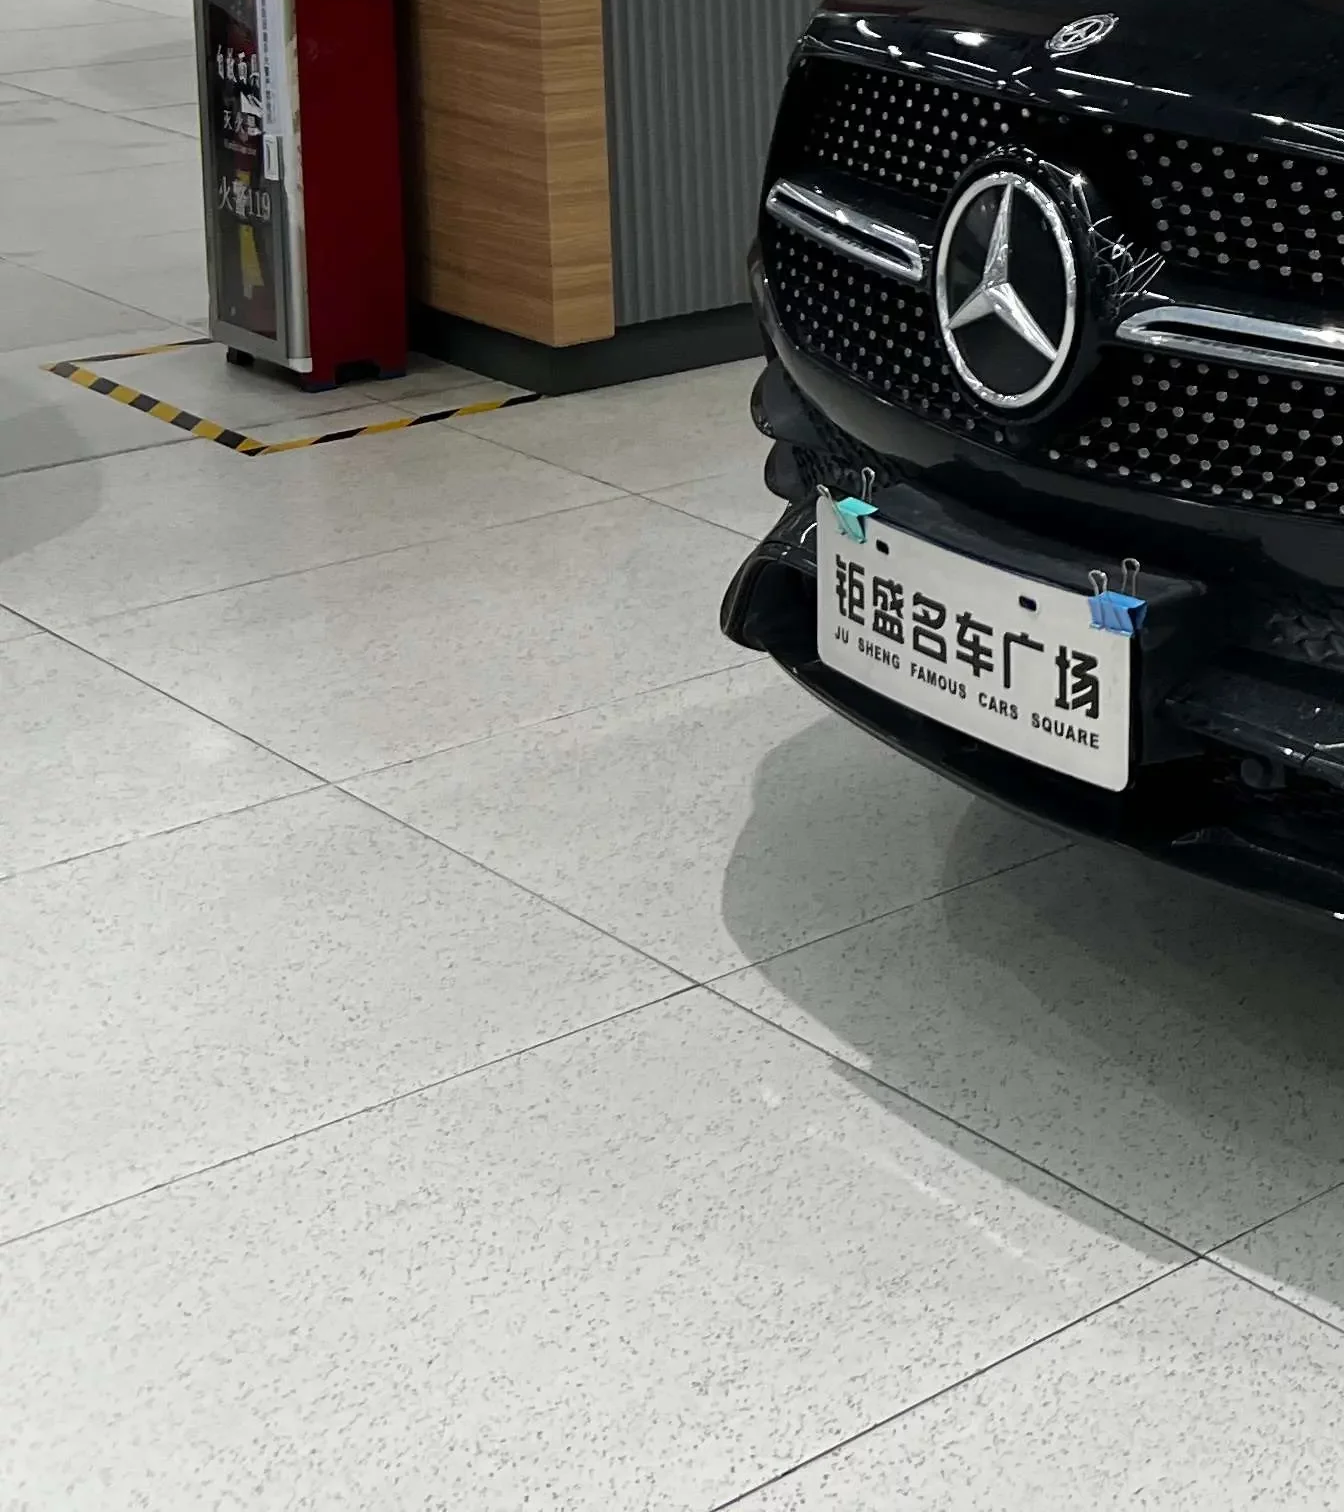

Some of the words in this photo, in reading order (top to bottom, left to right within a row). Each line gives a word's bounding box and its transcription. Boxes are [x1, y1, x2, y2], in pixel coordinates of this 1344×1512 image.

[834, 554, 1100, 720] 钜盛名车广场
[834, 625, 849, 644] JU
[858, 637, 901, 670] SHENG
[911, 662, 967, 700] FAMOUS
[978, 692, 1019, 720] CARS
[1031, 712, 1100, 750] SQUARE
